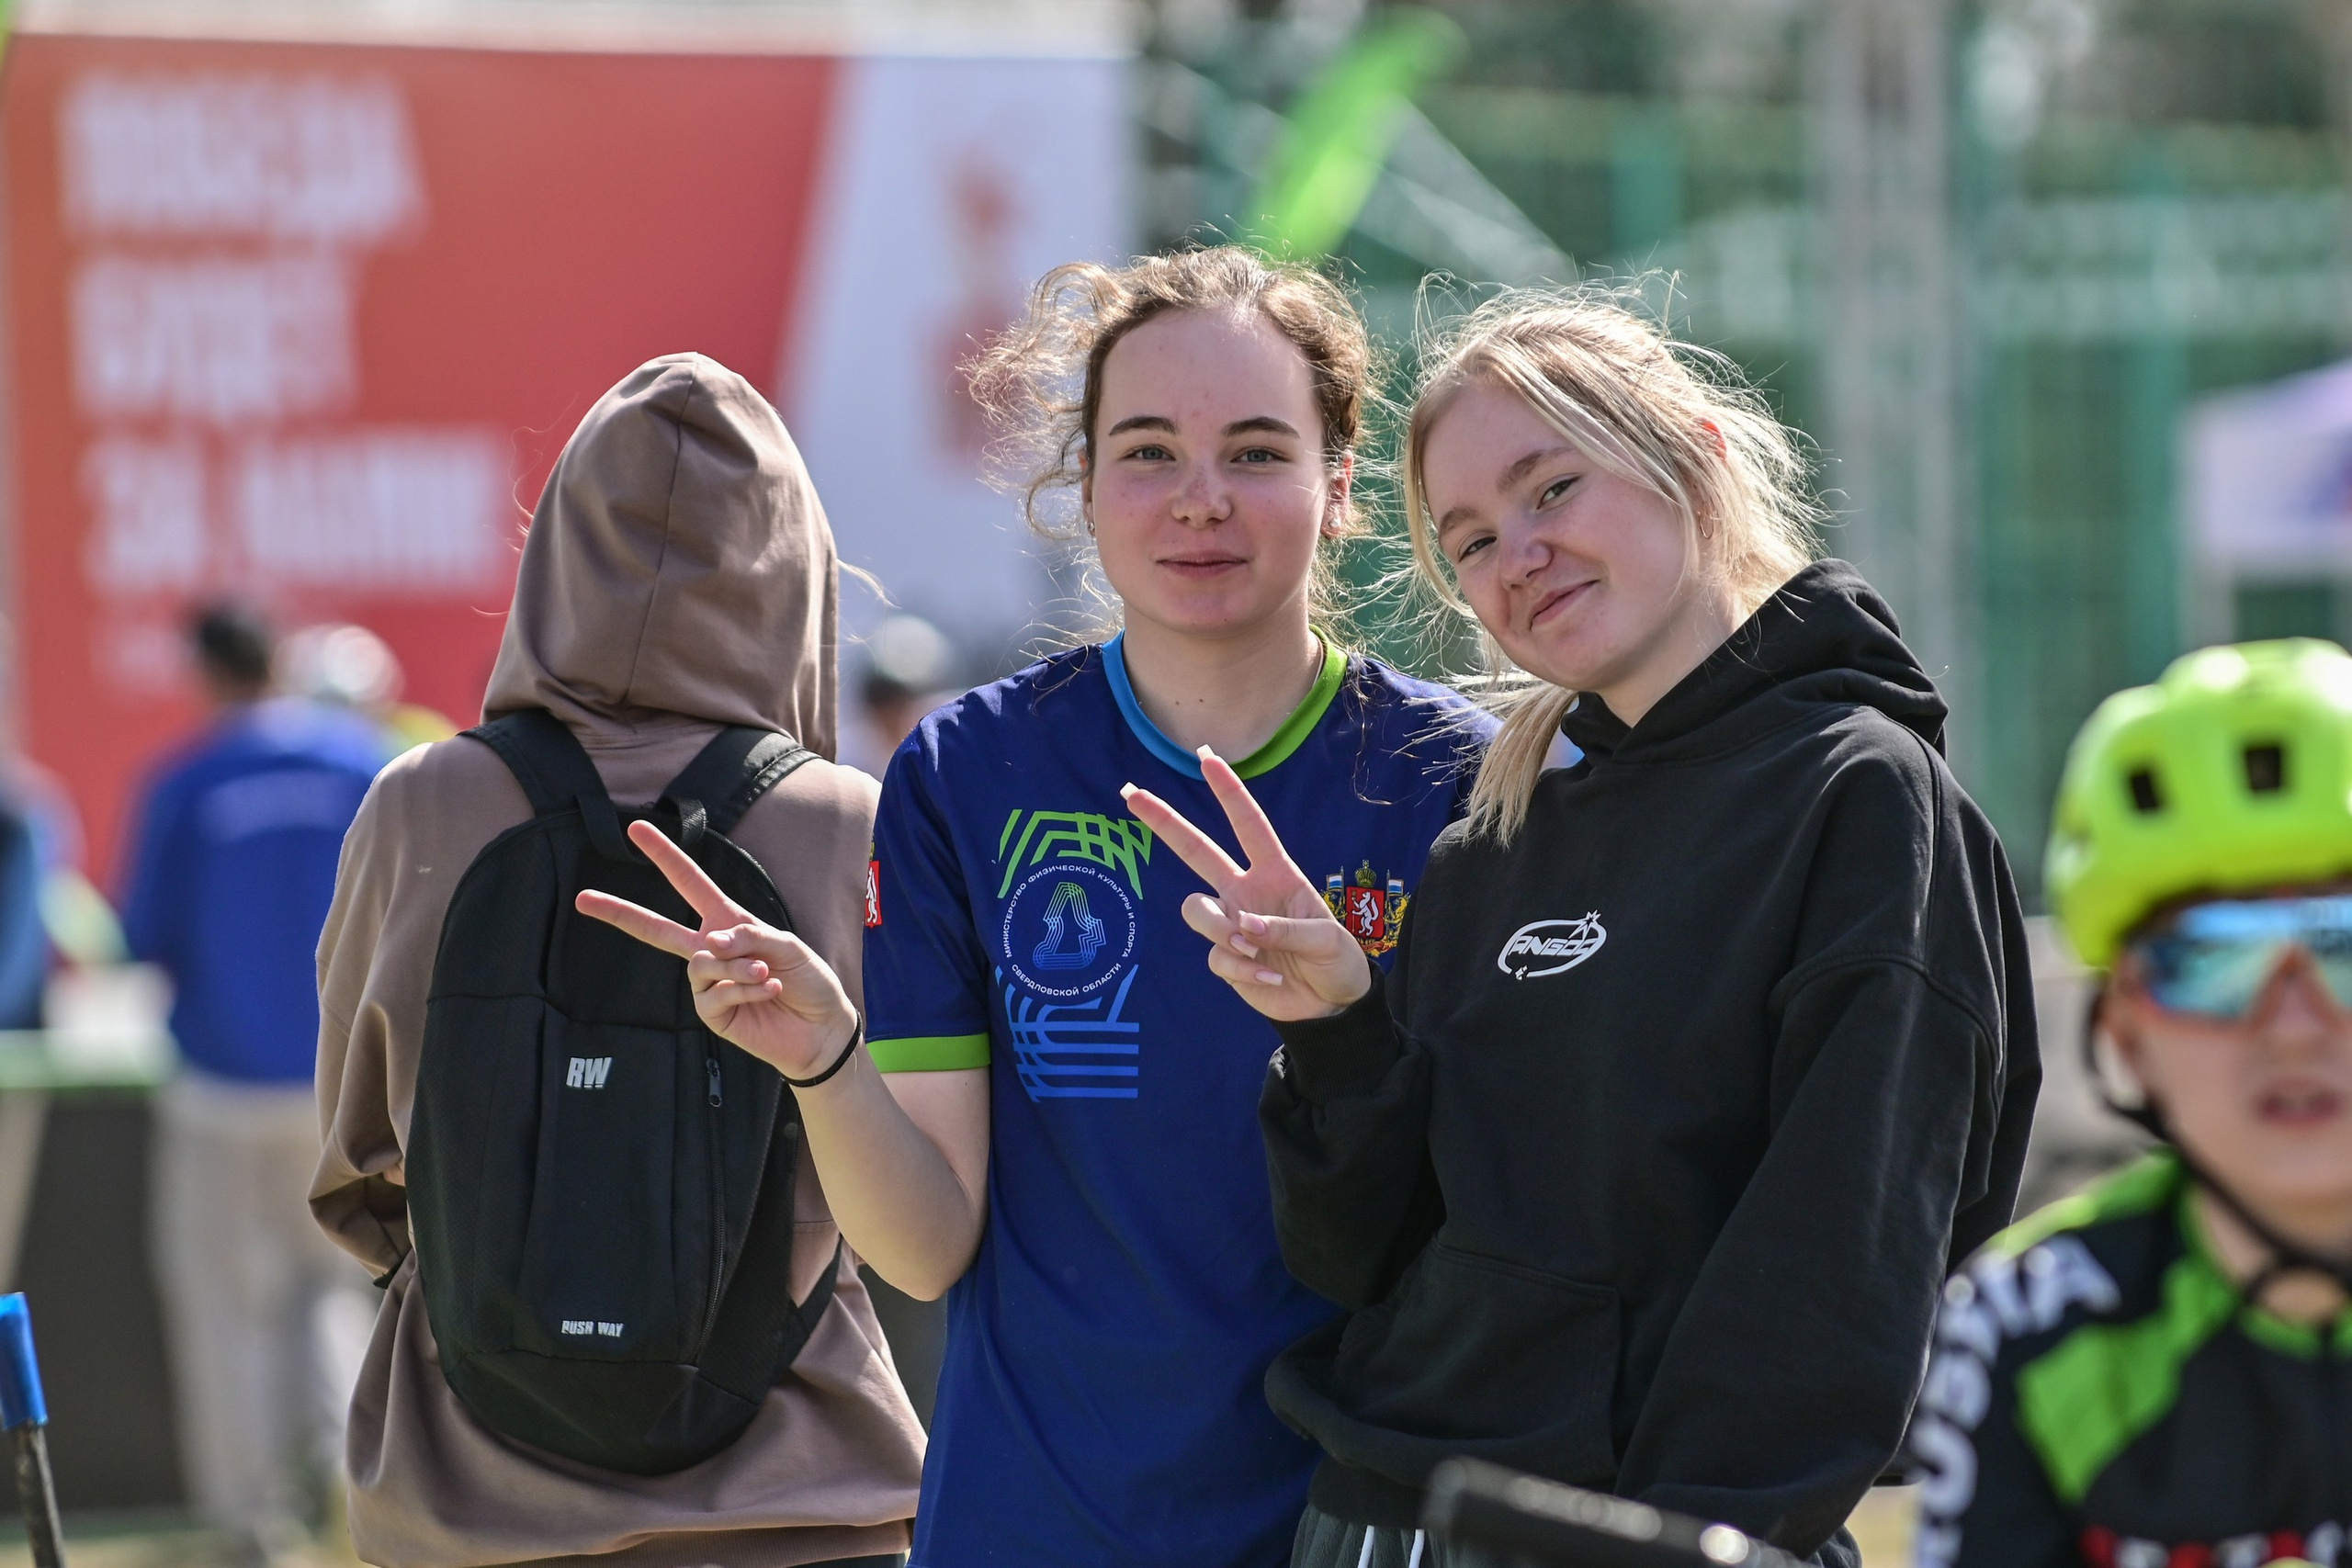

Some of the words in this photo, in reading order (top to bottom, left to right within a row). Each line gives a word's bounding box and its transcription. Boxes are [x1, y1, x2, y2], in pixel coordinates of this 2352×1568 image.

[1002, 882, 1027, 958] МИНИСТЕРСТВО
[1027, 864, 1096, 883] ФИЗИЧЕСКОЙ
[1097, 873, 1132, 910] КУЛЬТУРЫ
[1121, 921, 1136, 958] СПОРТА
[1012, 964, 1080, 997] СВЕРДЛОВСКОЙ
[1082, 962, 1122, 993] ОБЛАСТИ
[566, 1057, 613, 1089] RW
[597, 1322, 624, 1337] WAY
